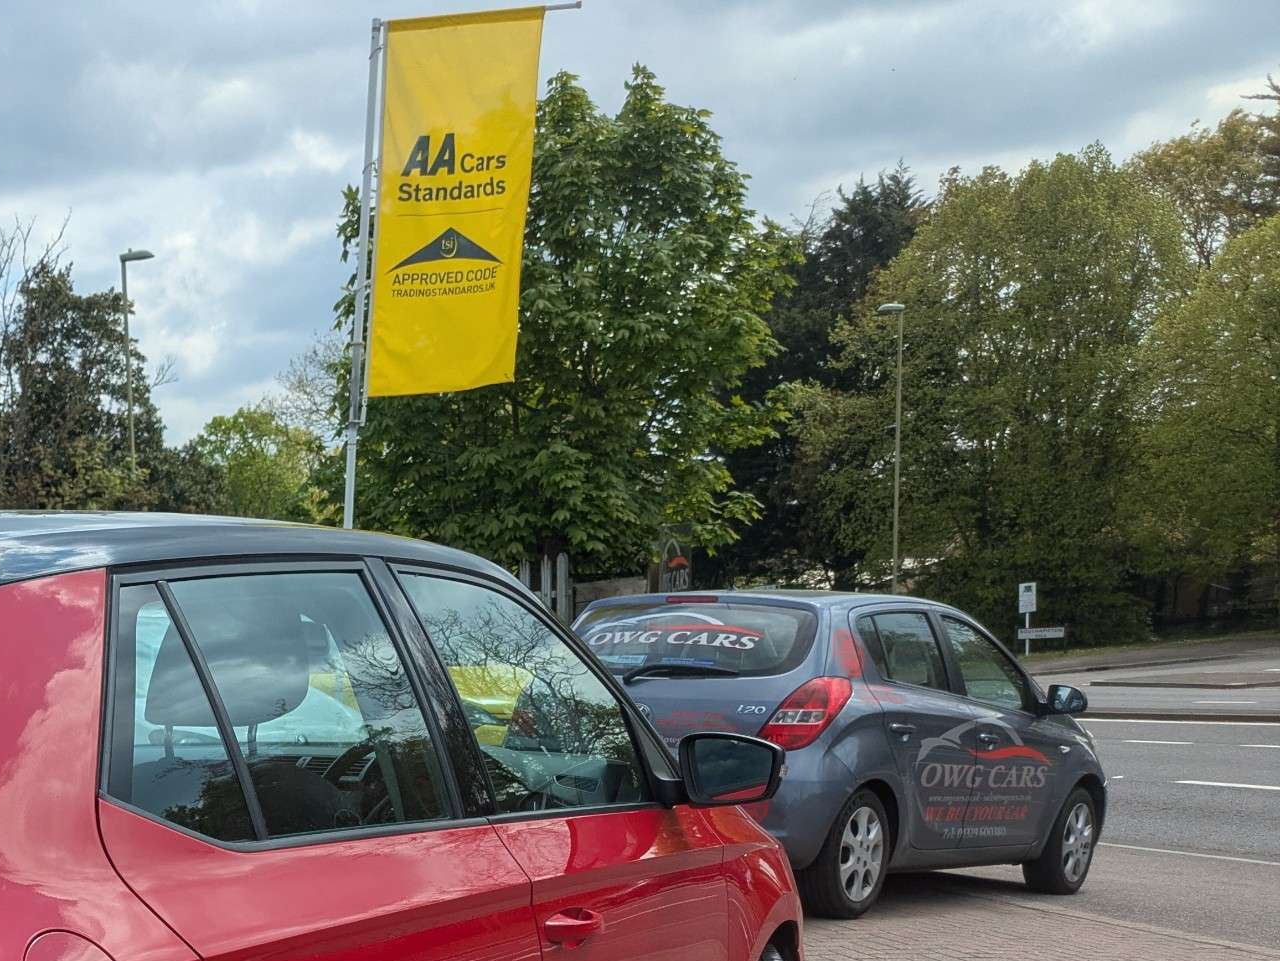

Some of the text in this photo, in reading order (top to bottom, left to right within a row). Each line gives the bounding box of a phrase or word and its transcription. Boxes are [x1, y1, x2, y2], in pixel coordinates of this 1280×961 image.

[401, 133, 506, 177] AA Cars
[398, 177, 506, 202] Standards
[392, 266, 497, 286] APPROVED CODE
[588, 630, 760, 650] OWG CARS
[920, 763, 1048, 788] OWG CARS
